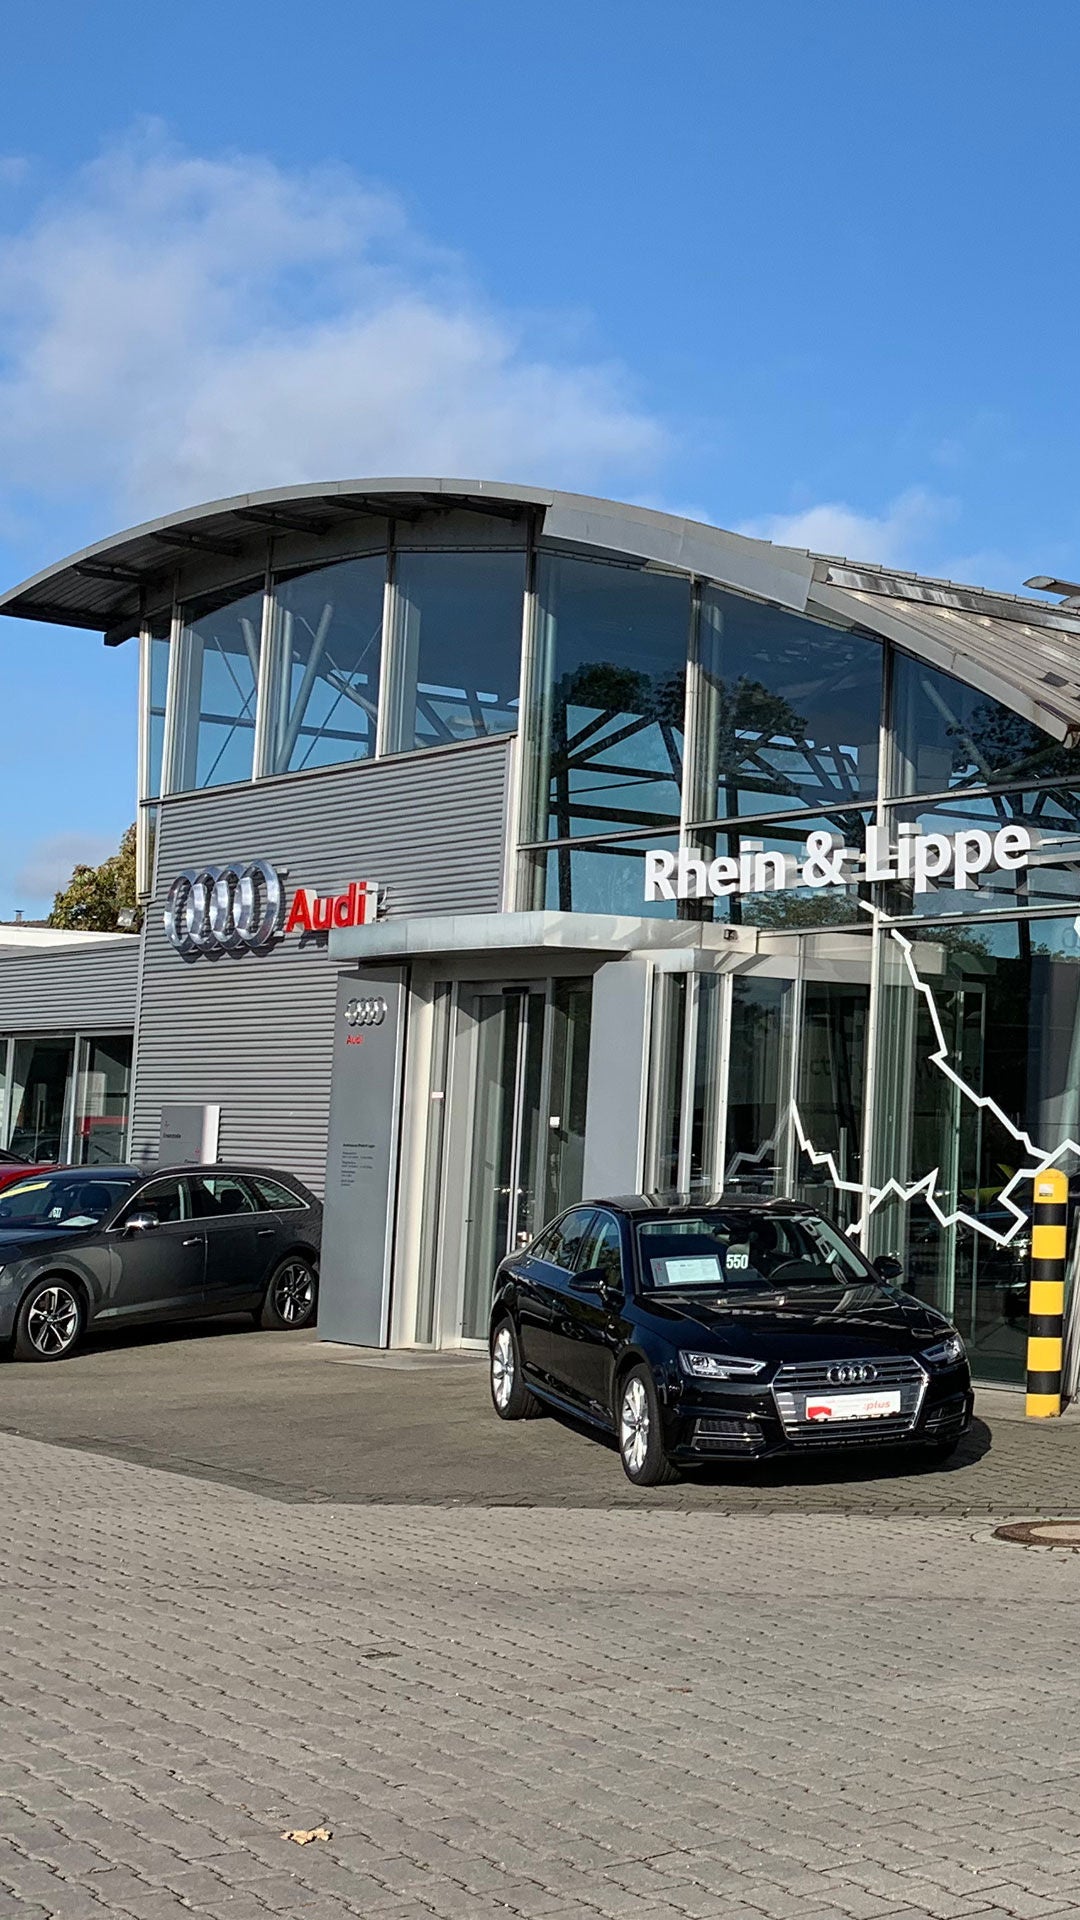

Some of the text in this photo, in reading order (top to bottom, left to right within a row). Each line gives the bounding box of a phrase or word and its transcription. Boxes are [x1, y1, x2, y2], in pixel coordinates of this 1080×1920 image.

[644, 822, 1032, 901] Rhein & Lippe
[284, 881, 369, 933] Audi
[726, 1254, 749, 1269] 550
